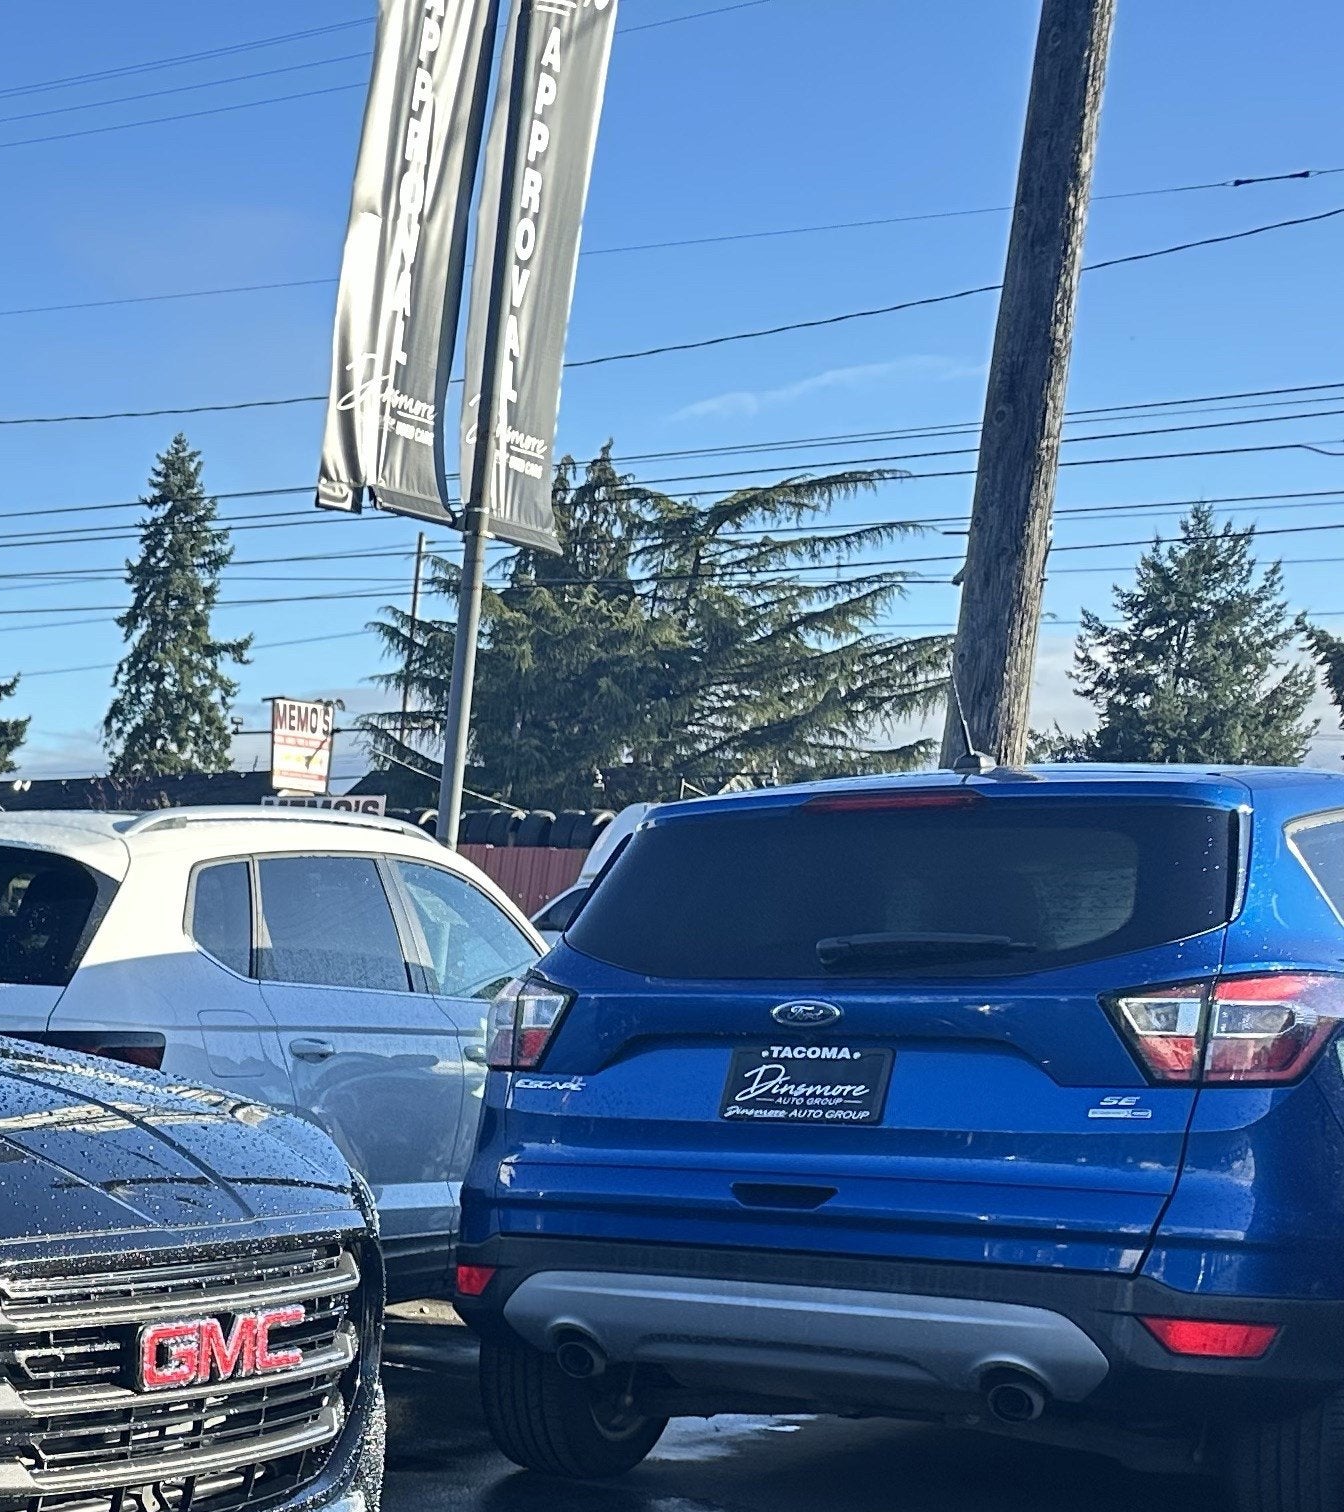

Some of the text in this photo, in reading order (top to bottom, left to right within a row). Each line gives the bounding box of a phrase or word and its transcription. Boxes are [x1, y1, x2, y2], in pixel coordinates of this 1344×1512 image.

[502, 26, 561, 403] APPROVAL
[275, 702, 330, 736] MEMO'S
[770, 1046, 851, 1060] TACOMA
[735, 1064, 869, 1101] Dinsmore
[775, 1096, 844, 1106] AUTO GROUP
[1099, 1096, 1141, 1106] SE
[789, 1109, 822, 1118] AUTO
[825, 1110, 869, 1120] GROUP
[141, 1304, 305, 1392] GMC
